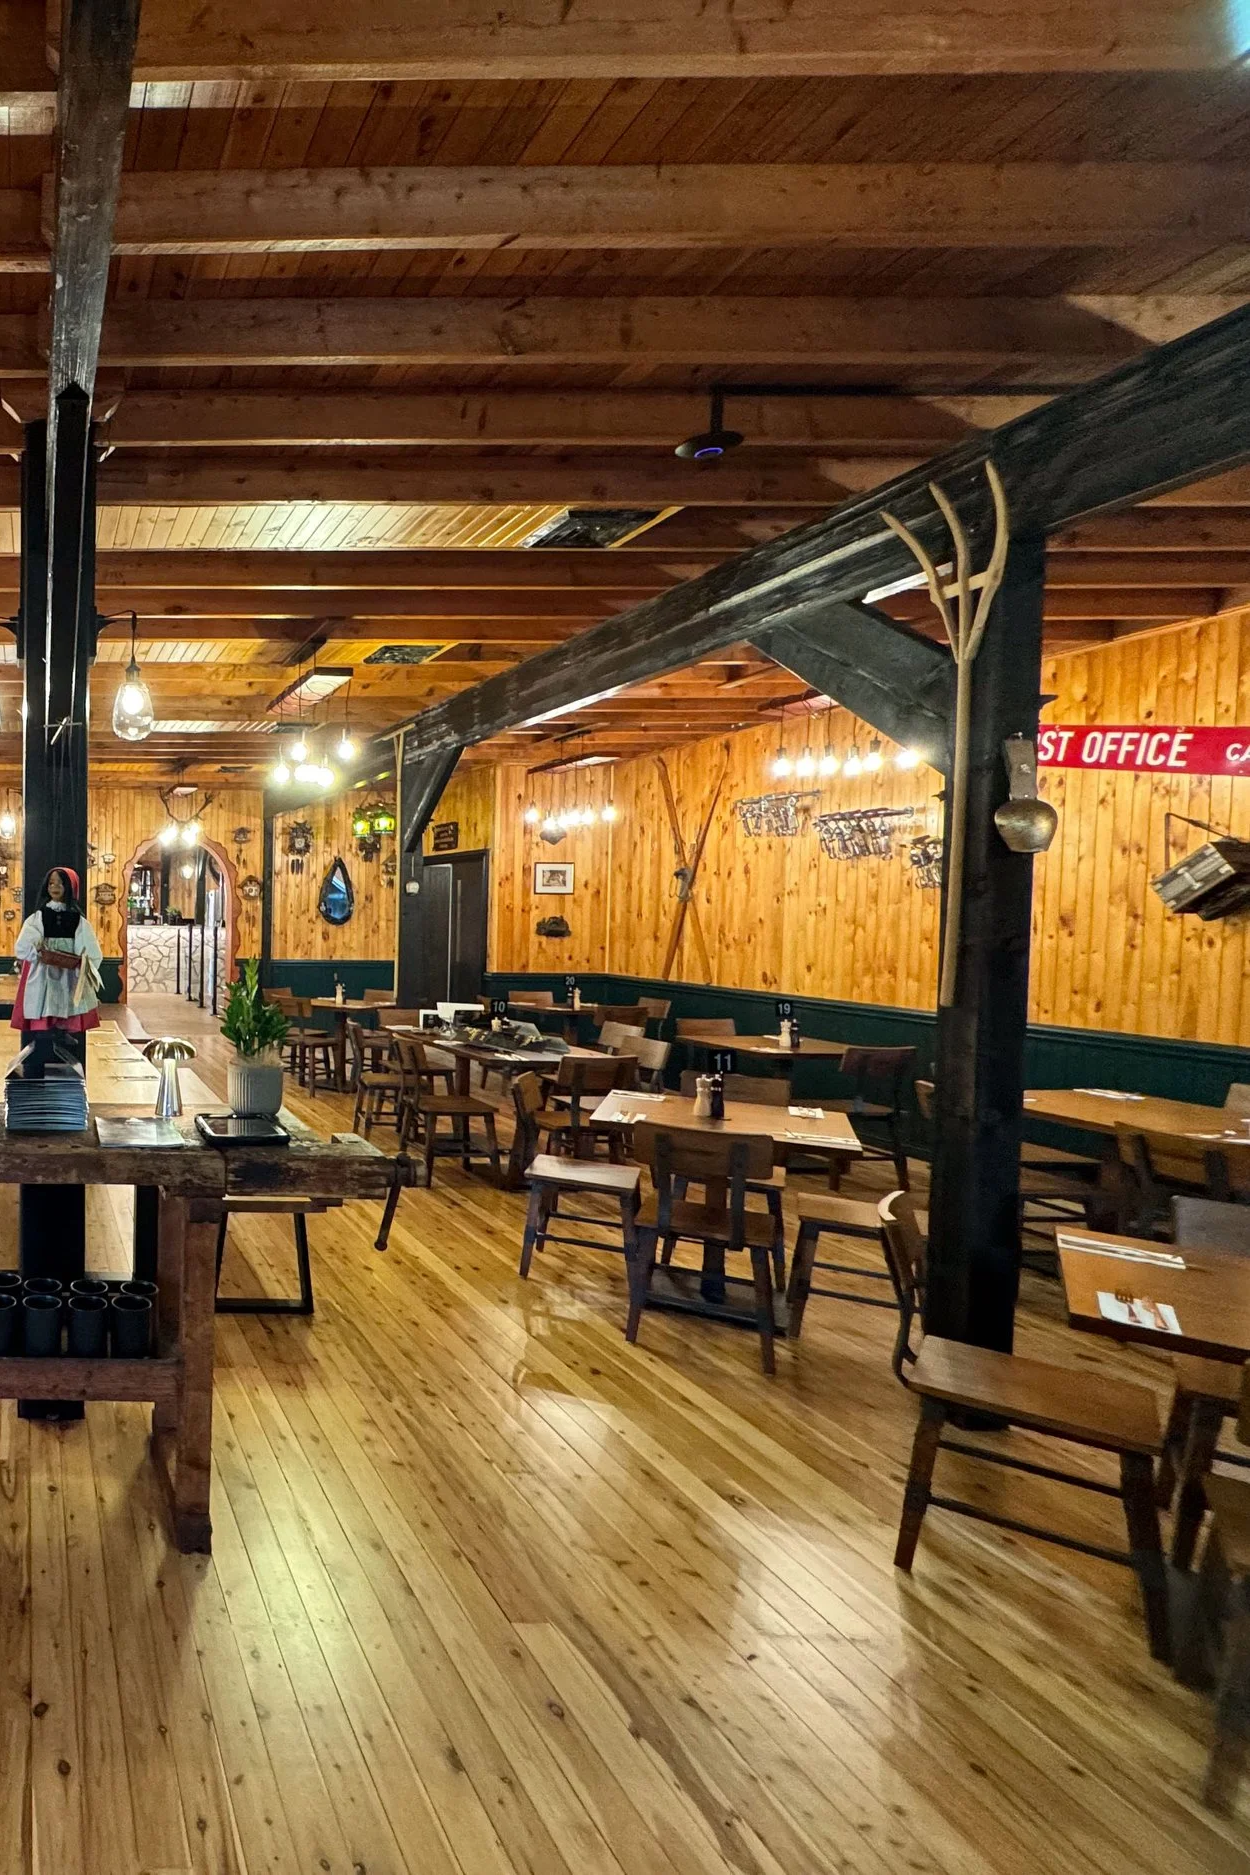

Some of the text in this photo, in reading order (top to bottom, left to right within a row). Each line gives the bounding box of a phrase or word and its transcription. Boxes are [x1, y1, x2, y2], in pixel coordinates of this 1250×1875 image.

[1037, 731, 1074, 761] ST
[1081, 732, 1194, 767] OFFICE
[565, 976, 575, 985] 20
[493, 1001, 505, 1013] 10
[778, 1003, 791, 1014] 19
[714, 1053, 731, 1071] 11
